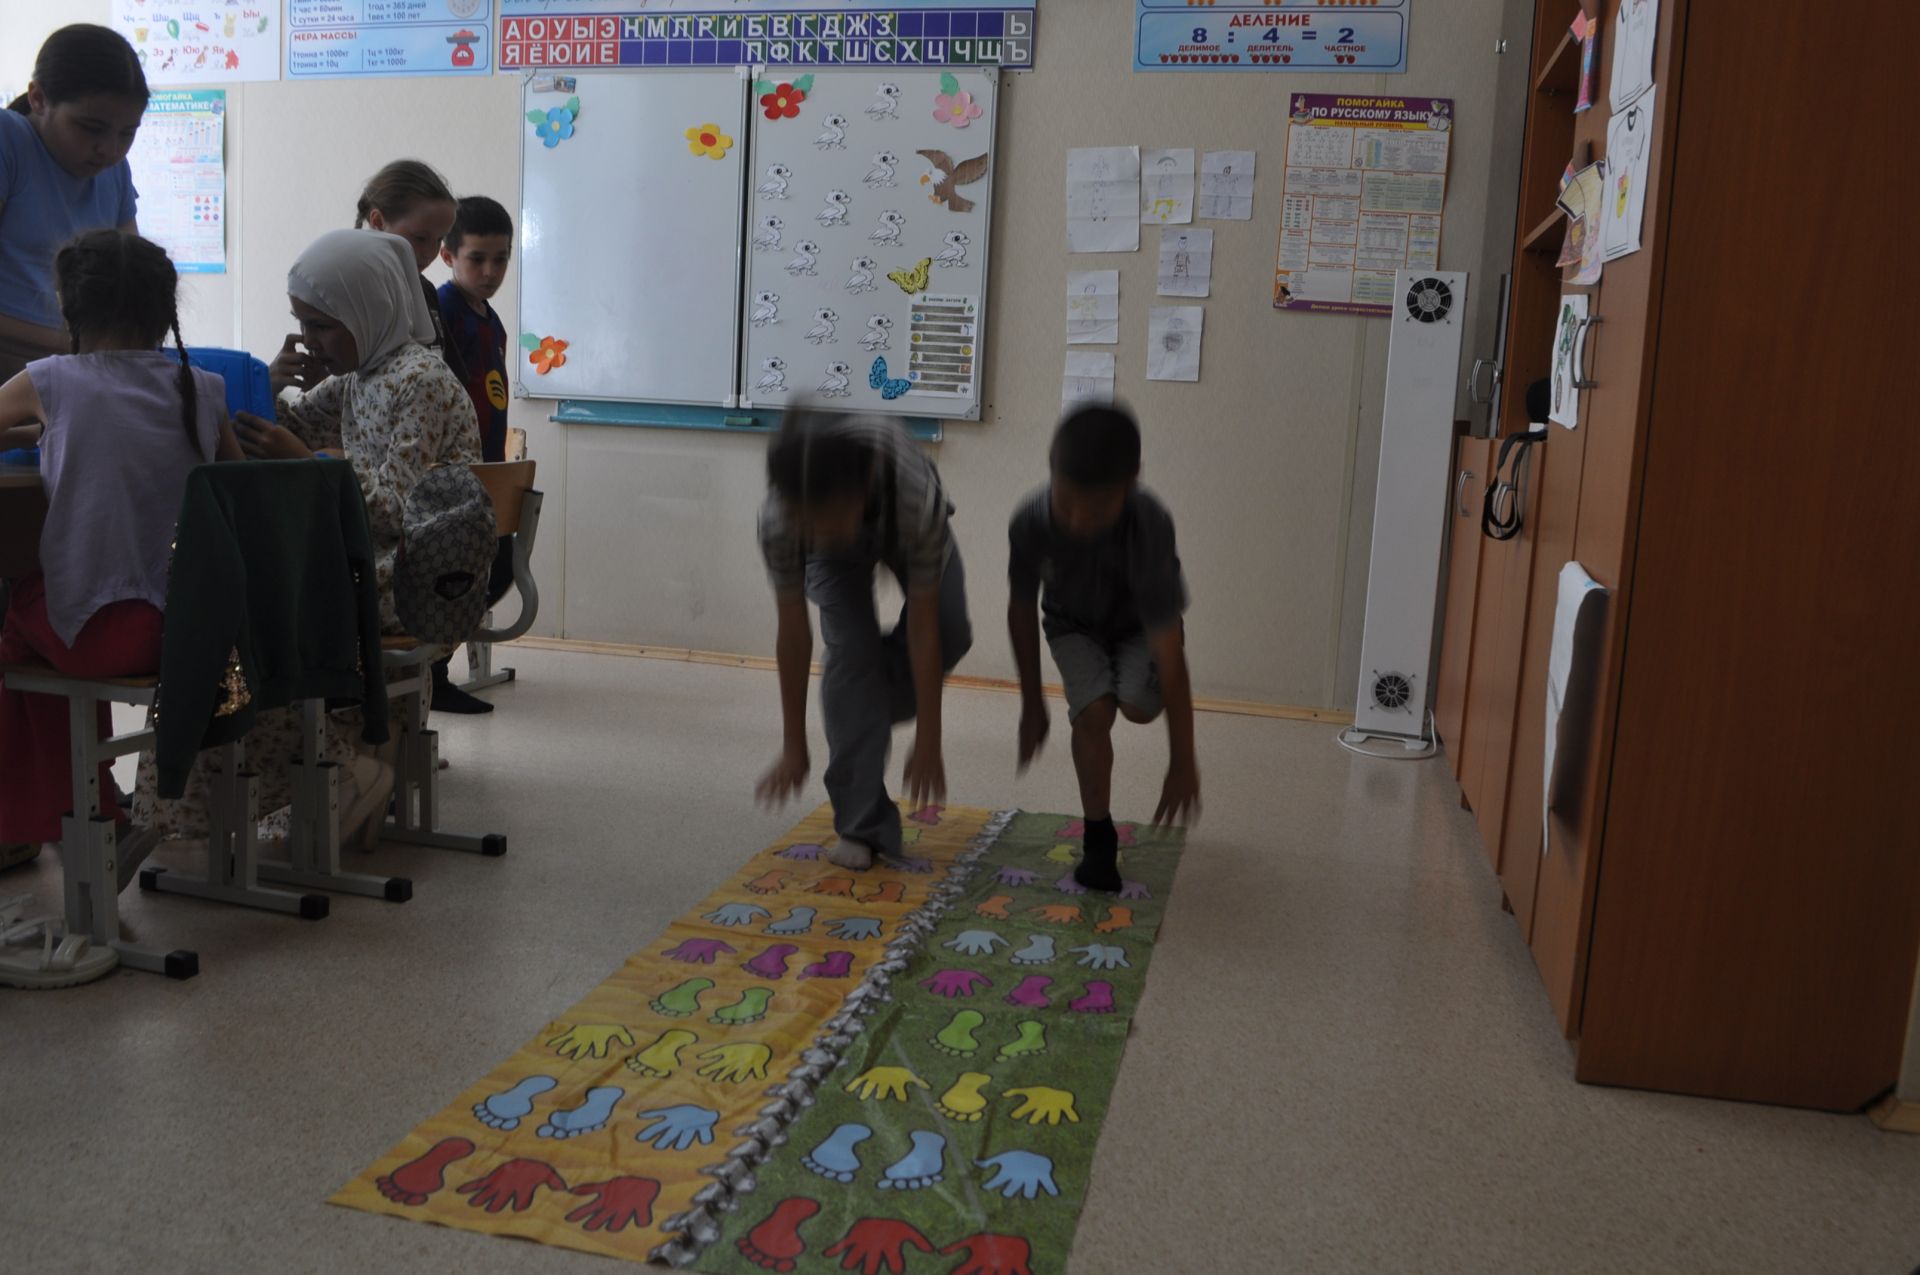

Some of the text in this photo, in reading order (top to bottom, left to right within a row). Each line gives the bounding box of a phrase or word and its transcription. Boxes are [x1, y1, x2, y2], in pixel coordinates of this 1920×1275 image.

[1229, 14, 1311, 28] ДЕЛЕНИЕ
[294, 31, 357, 41] МЕРА МАССЫ
[1192, 27, 1208, 43] 8
[1262, 27, 1280, 43] 4
[1302, 30, 1317, 40] =
[1337, 27, 1355, 43] 2
[1247, 44, 1294, 53] ДЕЛИТЕЛЬ
[1337, 97, 1405, 108] ПОМОГАЙКА
[1311, 107, 1434, 121] ПО РУССКОМУ ЯЗЫКУ
